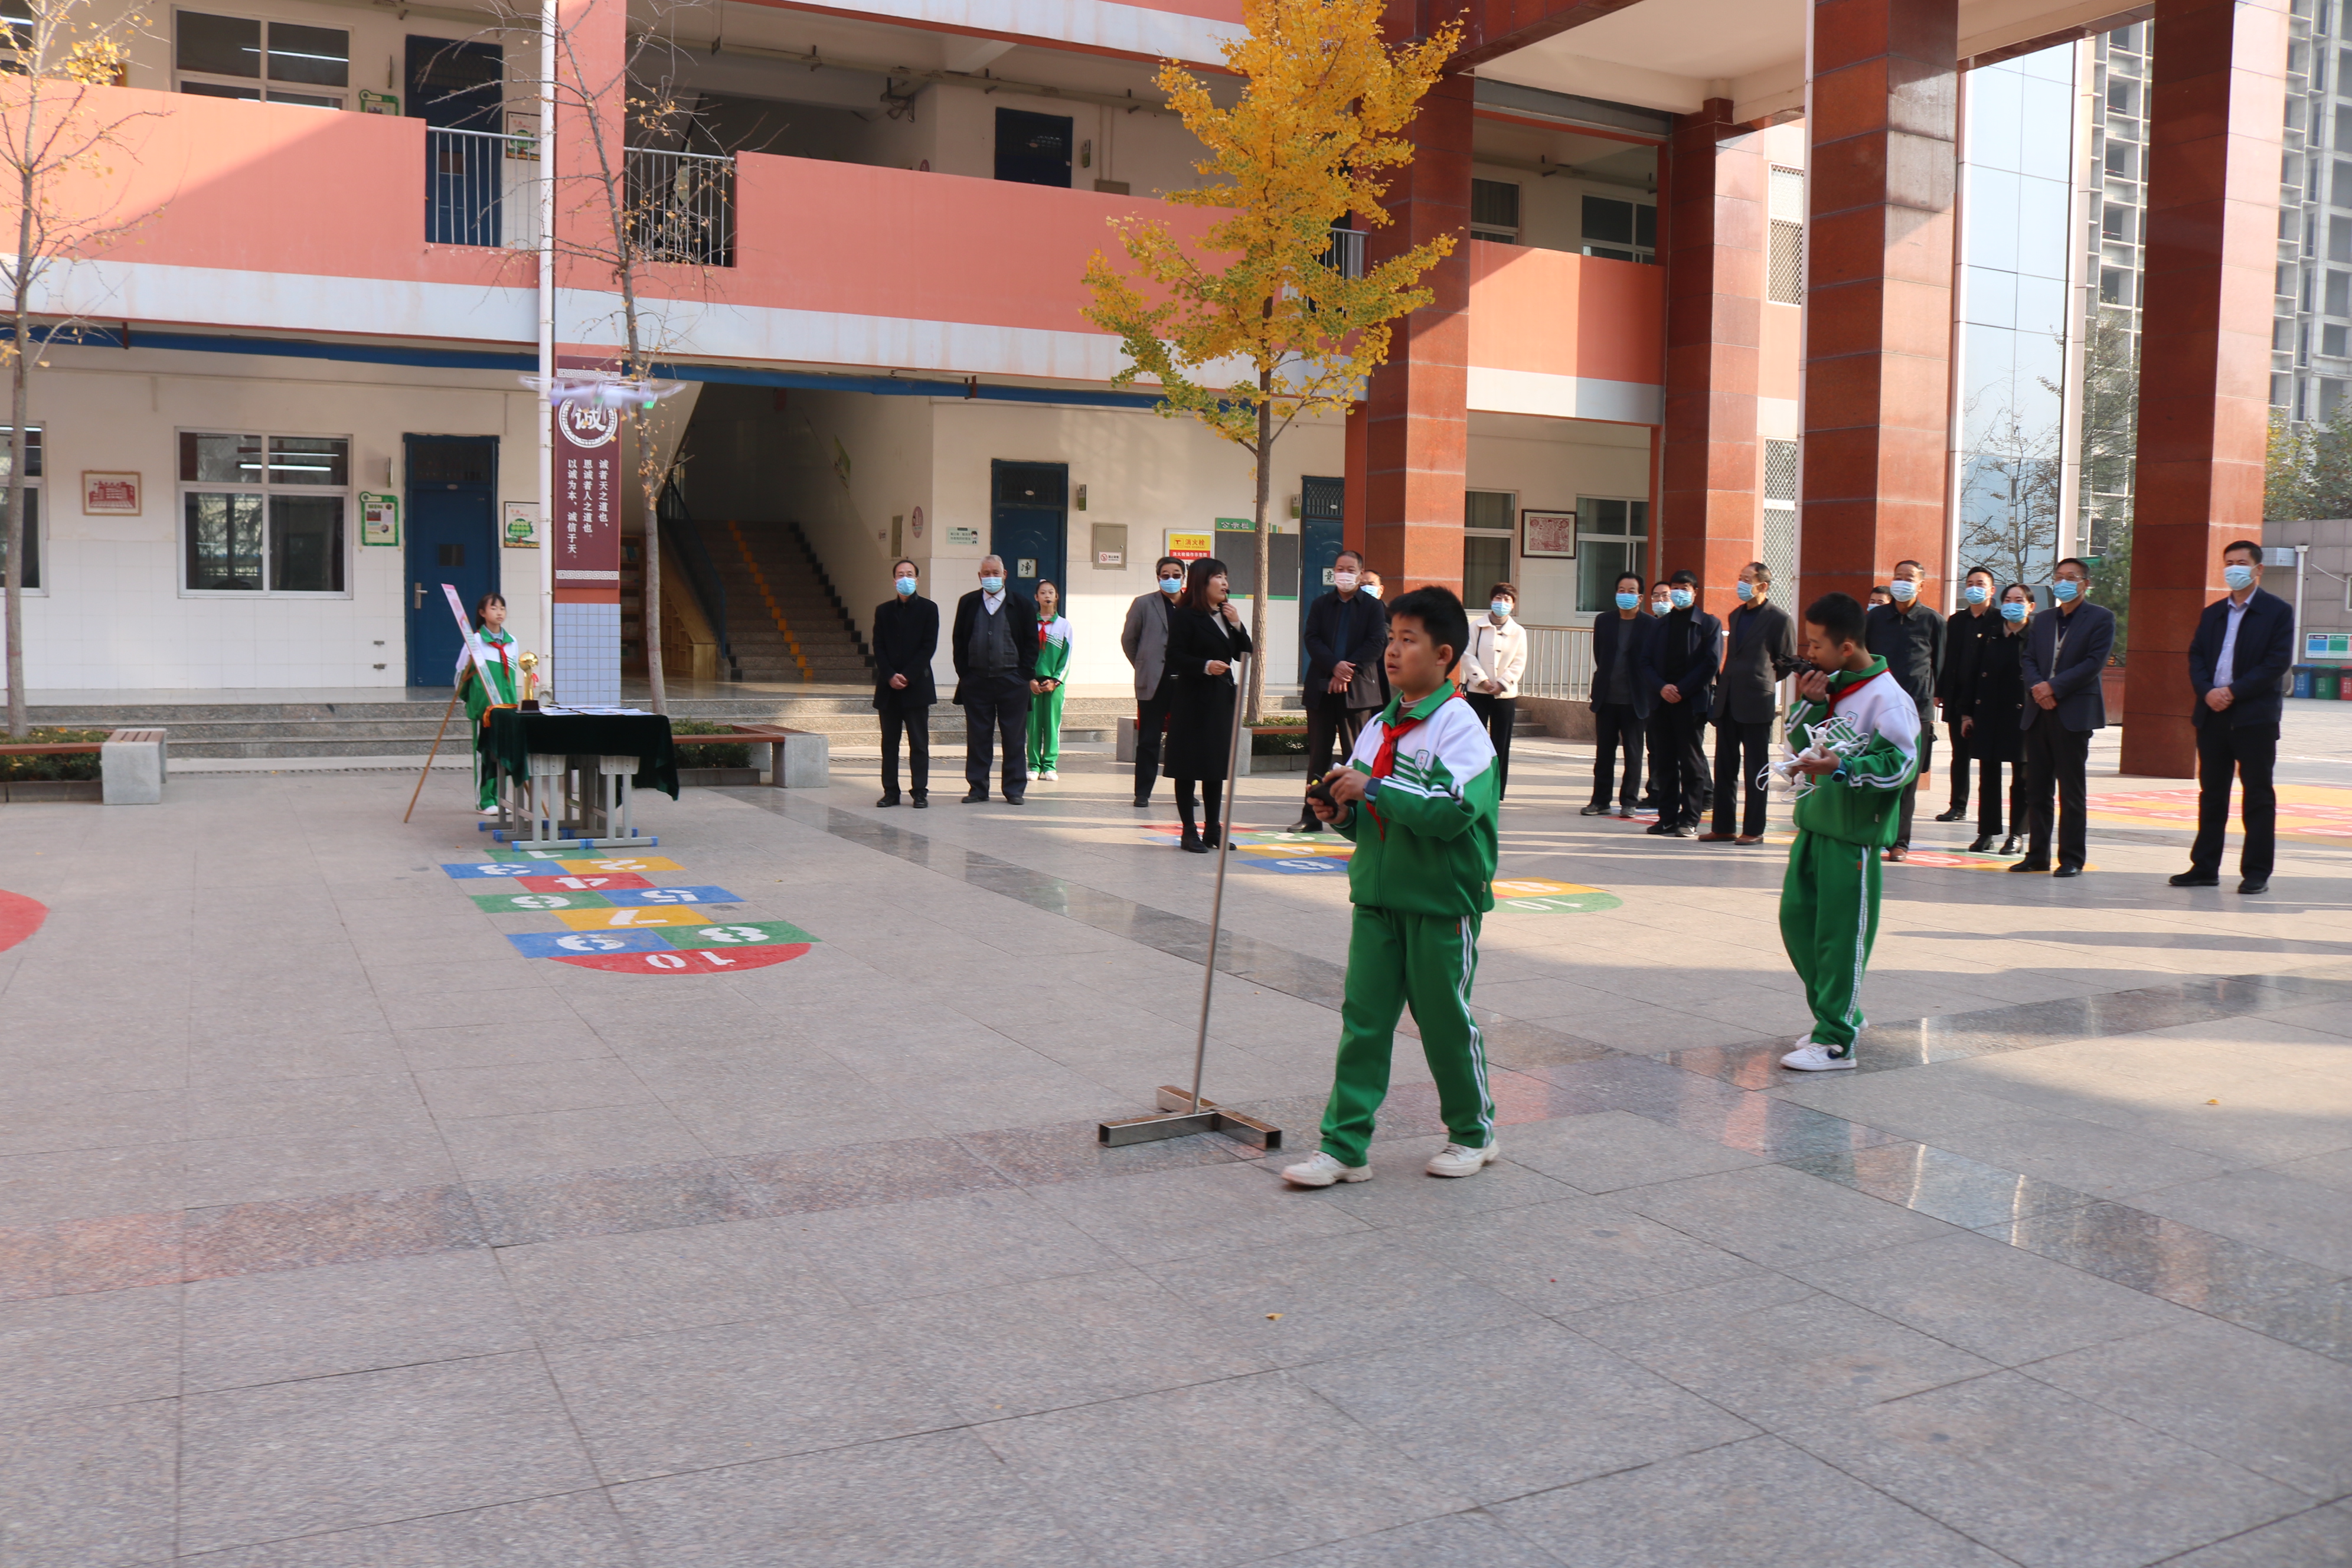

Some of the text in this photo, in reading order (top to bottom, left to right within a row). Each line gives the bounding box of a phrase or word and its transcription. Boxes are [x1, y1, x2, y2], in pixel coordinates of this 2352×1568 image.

[583, 459, 593, 538] 思诚者人之道也。
[598, 459, 609, 527] 诚者天之道也、
[567, 459, 577, 558] 以诚为本、诚信于天。
[1220, 521, 1250, 530] 公示栏
[1021, 561, 1032, 574] 净
[477, 864, 531, 875] 3
[590, 860, 648, 871] 2
[554, 877, 610, 889] 4
[1493, 881, 1562, 893] 8
[641, 889, 699, 903] 5
[1505, 898, 1584, 910] 10
[608, 909, 669, 925] 7
[698, 926, 770, 943] 8
[645, 951, 737, 969] 10
